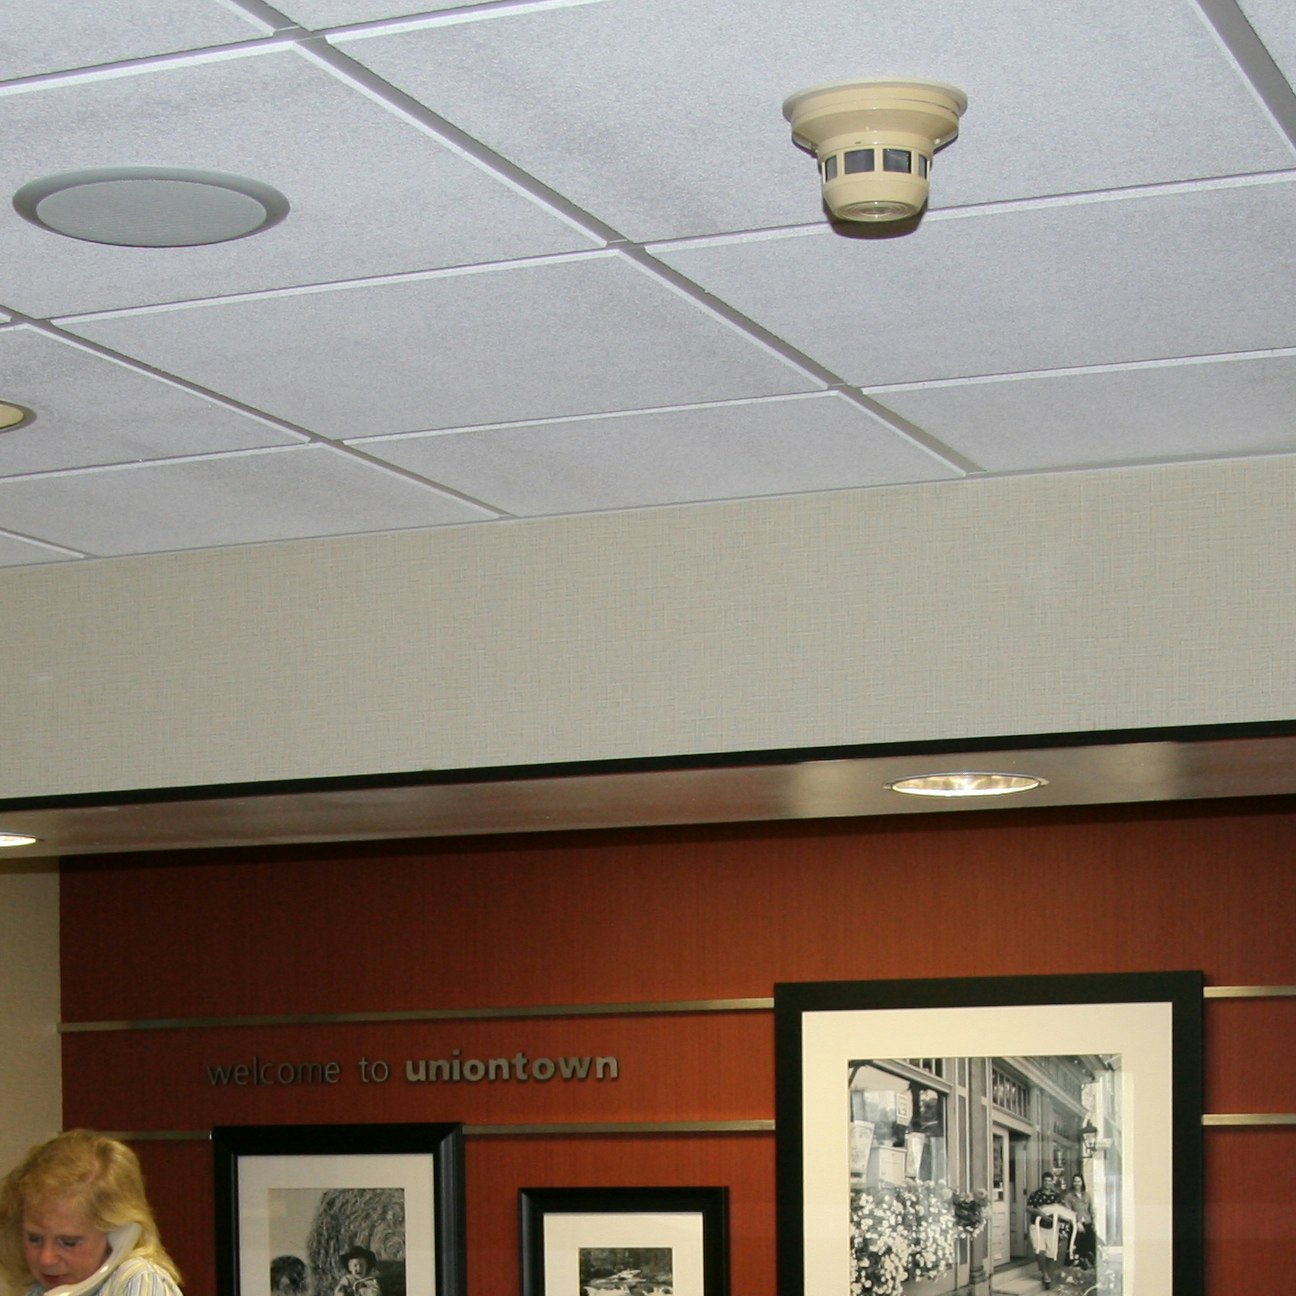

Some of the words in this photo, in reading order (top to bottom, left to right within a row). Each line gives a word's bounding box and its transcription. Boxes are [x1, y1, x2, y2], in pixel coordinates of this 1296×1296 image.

[207, 1056, 342, 1086] welcome
[359, 1056, 390, 1083] to
[405, 1049, 619, 1082] uniontown
